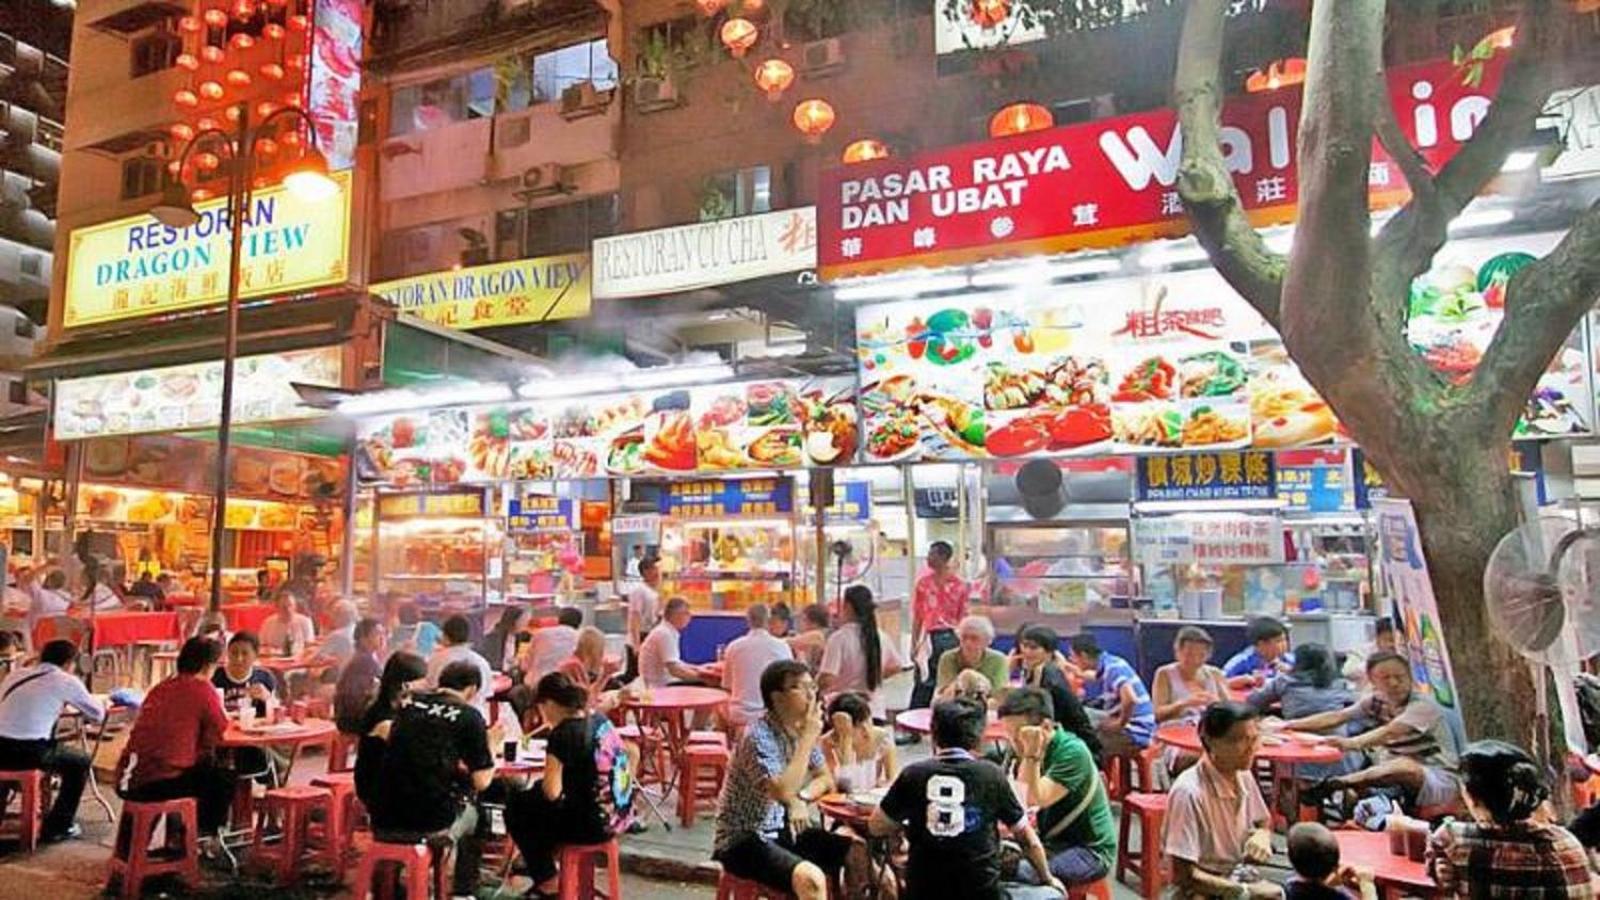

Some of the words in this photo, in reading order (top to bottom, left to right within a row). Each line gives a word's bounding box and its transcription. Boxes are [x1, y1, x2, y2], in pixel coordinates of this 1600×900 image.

[841, 165, 953, 204] PASAR
[972, 145, 1072, 184] RAYA
[841, 198, 910, 230] DAN
[931, 179, 1029, 217] UBAT
[96, 242, 211, 287] DRAGON
[600, 228, 695, 282] RESTORAN
[698, 220, 725, 268] CU
[727, 219, 769, 266] CHA
[452, 265, 528, 301] DRAGON
[530, 260, 585, 290] VIEW
[926, 774, 966, 838] 8
